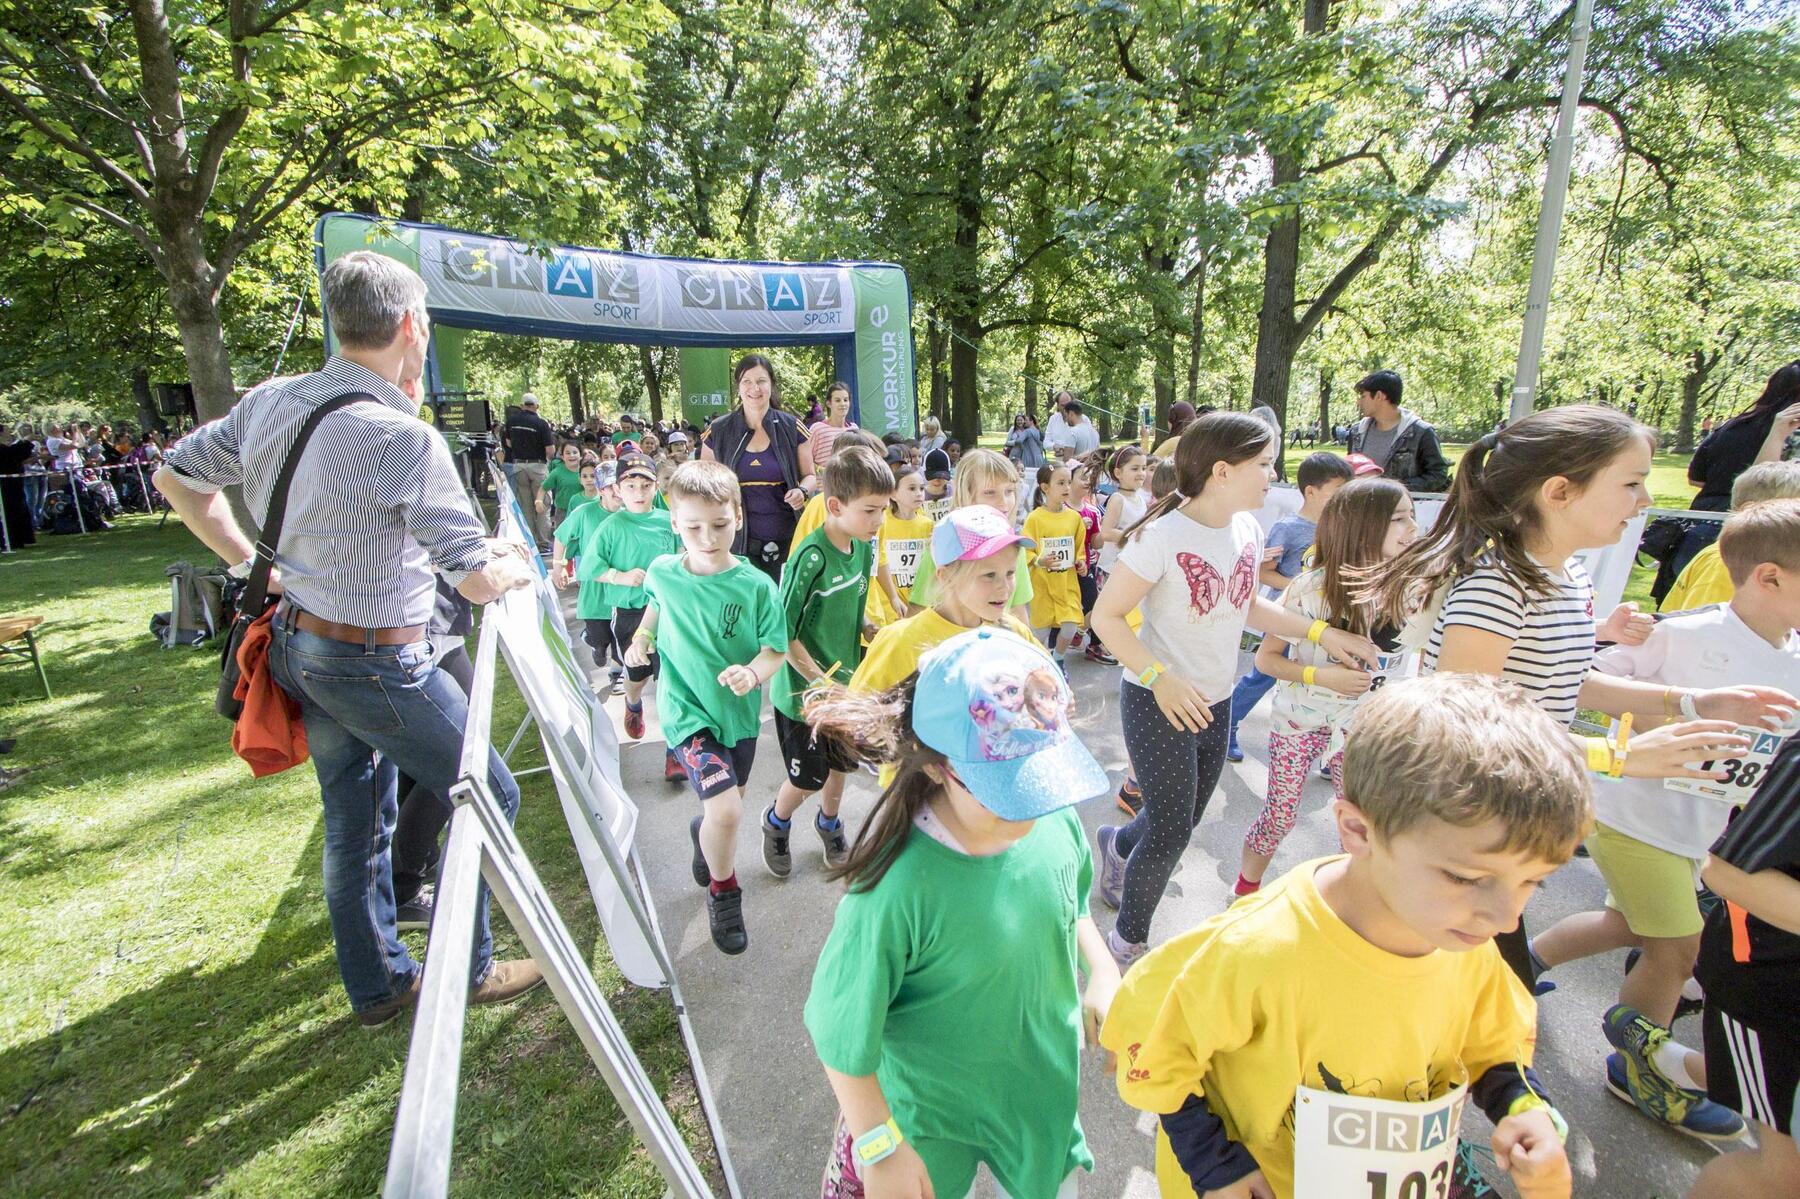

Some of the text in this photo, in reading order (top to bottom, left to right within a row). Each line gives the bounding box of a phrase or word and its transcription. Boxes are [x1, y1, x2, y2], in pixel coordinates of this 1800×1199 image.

[683, 273, 836, 307] GRAZ
[594, 302, 640, 321] SPORT
[803, 310, 842, 326] SPORT
[690, 394, 728, 405] GRAZ
[900, 554, 916, 566] 97
[790, 758, 801, 777] 5
